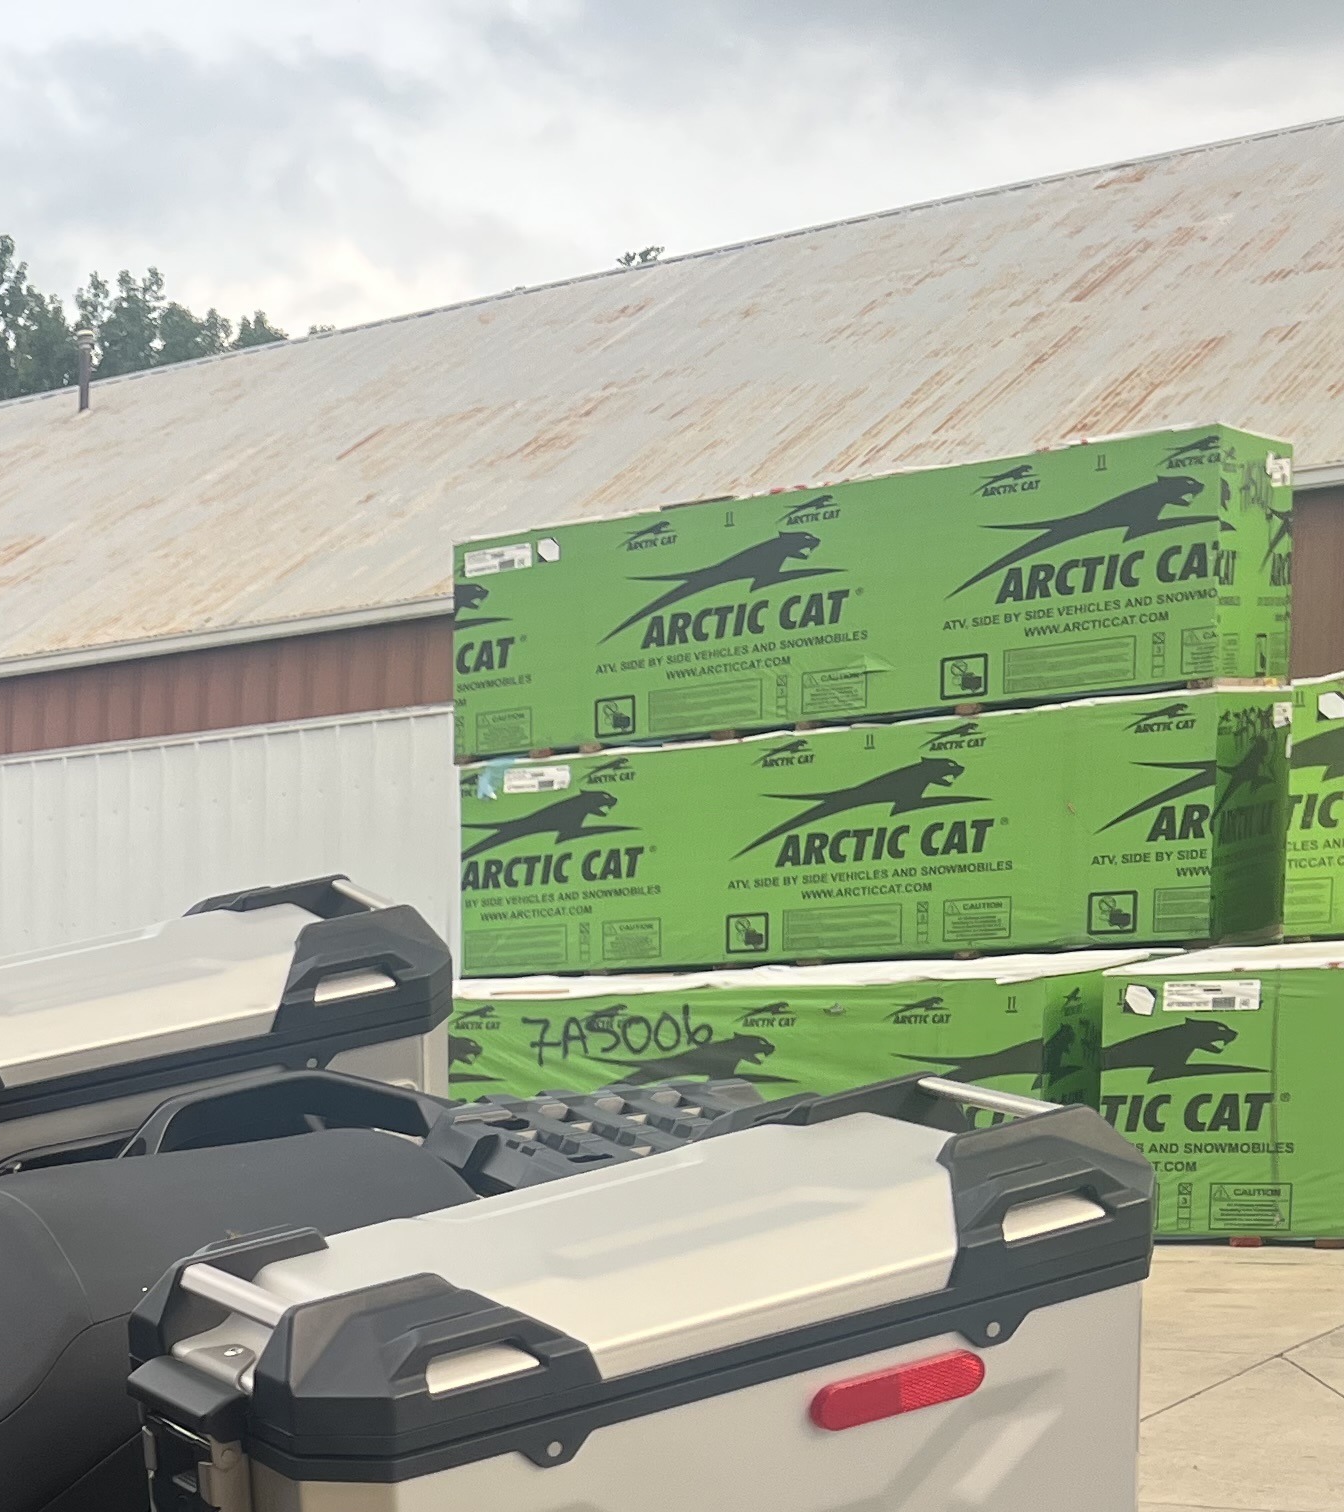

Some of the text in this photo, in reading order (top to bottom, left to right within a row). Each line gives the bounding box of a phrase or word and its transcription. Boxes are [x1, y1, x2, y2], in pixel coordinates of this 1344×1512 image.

[982, 479, 1040, 497] ARCTIC CAT
[786, 509, 841, 526] ARCTIC CAT
[626, 534, 678, 551] ARCTIC CAT
[994, 550, 1145, 604] ARCTIC
[942, 588, 1218, 631] ATV, SIDE BY SIDE VEHICLES AND SNOWMO
[641, 589, 851, 649] ARCTIC CAT
[1024, 611, 1170, 638] WWW.ARCTICCAT.COM
[456, 637, 516, 674] CAT
[595, 630, 869, 675] ATV, SIDE BY SIDE VEHICLES AND SNOWMOBILES
[666, 656, 791, 681] WWW.ARCTICCAT.COM
[456, 674, 533, 693] SNOWMOBILES
[1134, 718, 1196, 734] ARCTIC CAT
[929, 737, 986, 752] ARCTIC CAT
[762, 754, 815, 768] ARCTIC CAT
[587, 772, 636, 785] ARCTIC CAT
[1288, 791, 1344, 833] TIC
[775, 818, 995, 868] ARCTIC CAT
[1322, 838, 1344, 850] AN
[1091, 848, 1208, 867] ATV, SIDE BY SIDE
[462, 846, 645, 892] ARCTIC CAT
[727, 860, 1013, 890] ATV, SIDE BY SIDE VEHICLES AND SNOWMOBILES
[465, 884, 661, 908] BY SIDE VEHICLES AND SNOWMOBILES
[801, 882, 933, 900] WWW.ARCTICCAT.COM
[480, 905, 593, 922] WWW.ARCTICCAT.COM
[962, 901, 1003, 911] CAUTION
[484, 1019, 500, 1030] CAT
[742, 1015, 797, 1028] ARCTIC CAT
[893, 1013, 951, 1025] ARCTIC CAT
[1101, 1093, 1275, 1132] TIC CAT
[1148, 1143, 1179, 1154] AND
[1184, 1142, 1294, 1154] SNOWMOBILES
[1233, 1188, 1281, 1198] CAUTION
